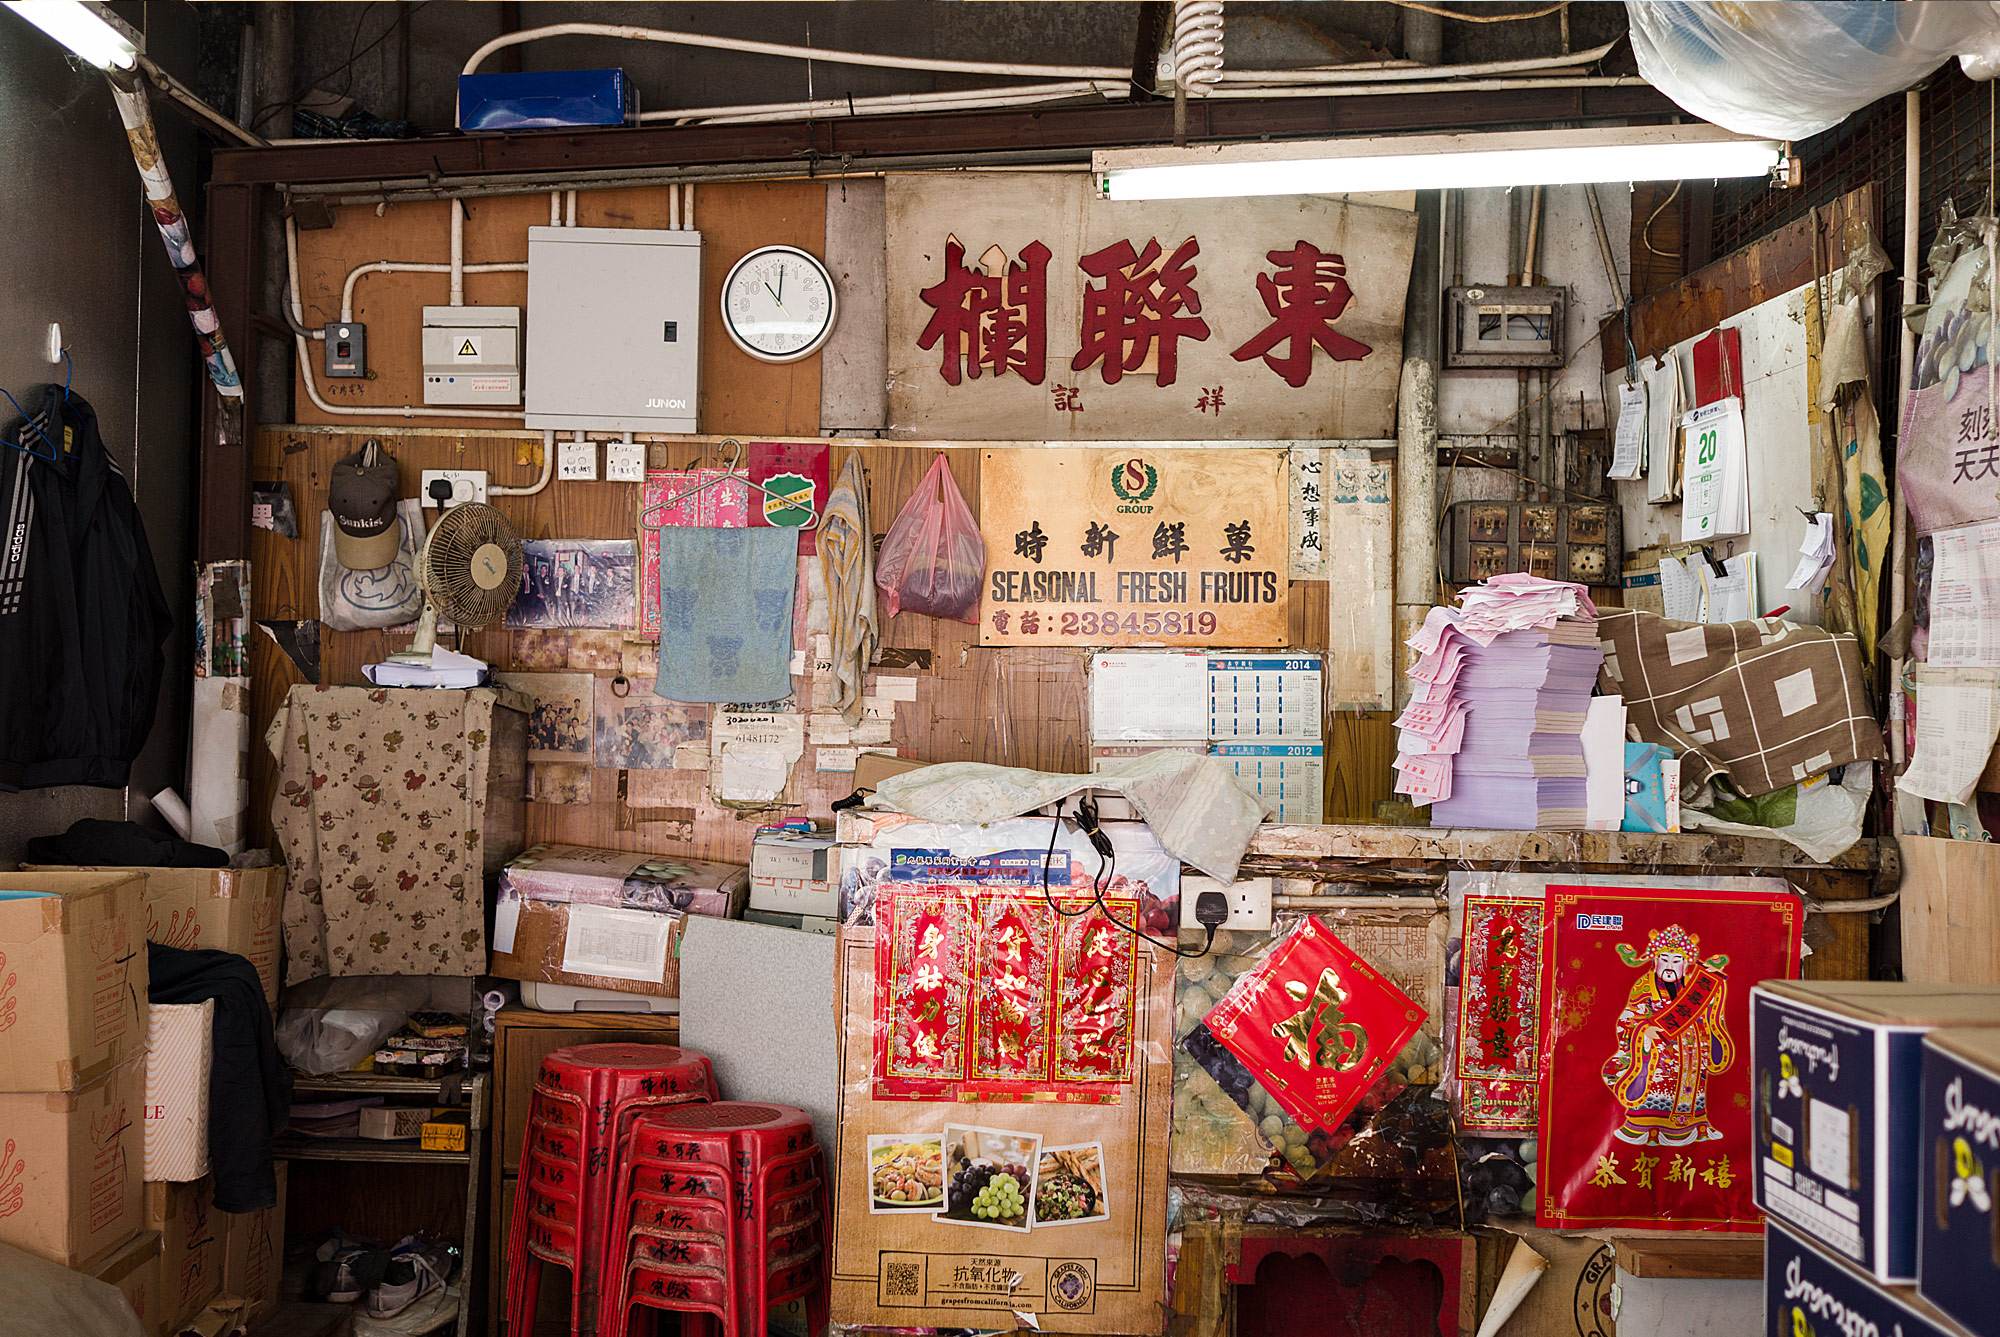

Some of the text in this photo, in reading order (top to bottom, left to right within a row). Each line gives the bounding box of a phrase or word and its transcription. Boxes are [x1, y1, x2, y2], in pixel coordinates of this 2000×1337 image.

[771, 263, 788, 276] 12
[743, 281, 760, 295] 10
[803, 277, 814, 291] 2
[740, 298, 750, 312] 9
[809, 297, 819, 311] 3
[645, 398, 686, 409] JUNON
[1699, 430, 1717, 465] 20
[1126, 458, 1145, 492] S
[1116, 506, 1154, 514] GROUP
[1300, 461, 1323, 552] 心想事成
[340, 515, 384, 528] Sunkist
[11, 522, 25, 563] adidas
[1014, 520, 1256, 564] 時新鮮菓
[991, 571, 1277, 604] SEASONAL FRESH FRUITS
[1285, 661, 1310, 670] 2014
[735, 734, 780, 744] 61481172
[1287, 747, 1312, 756] 2012
[1272, 967, 1369, 1072] 福
[1587, 1151, 1737, 1192] 恭賀新禧
[953, 1265, 1017, 1284] 抗氧化物
